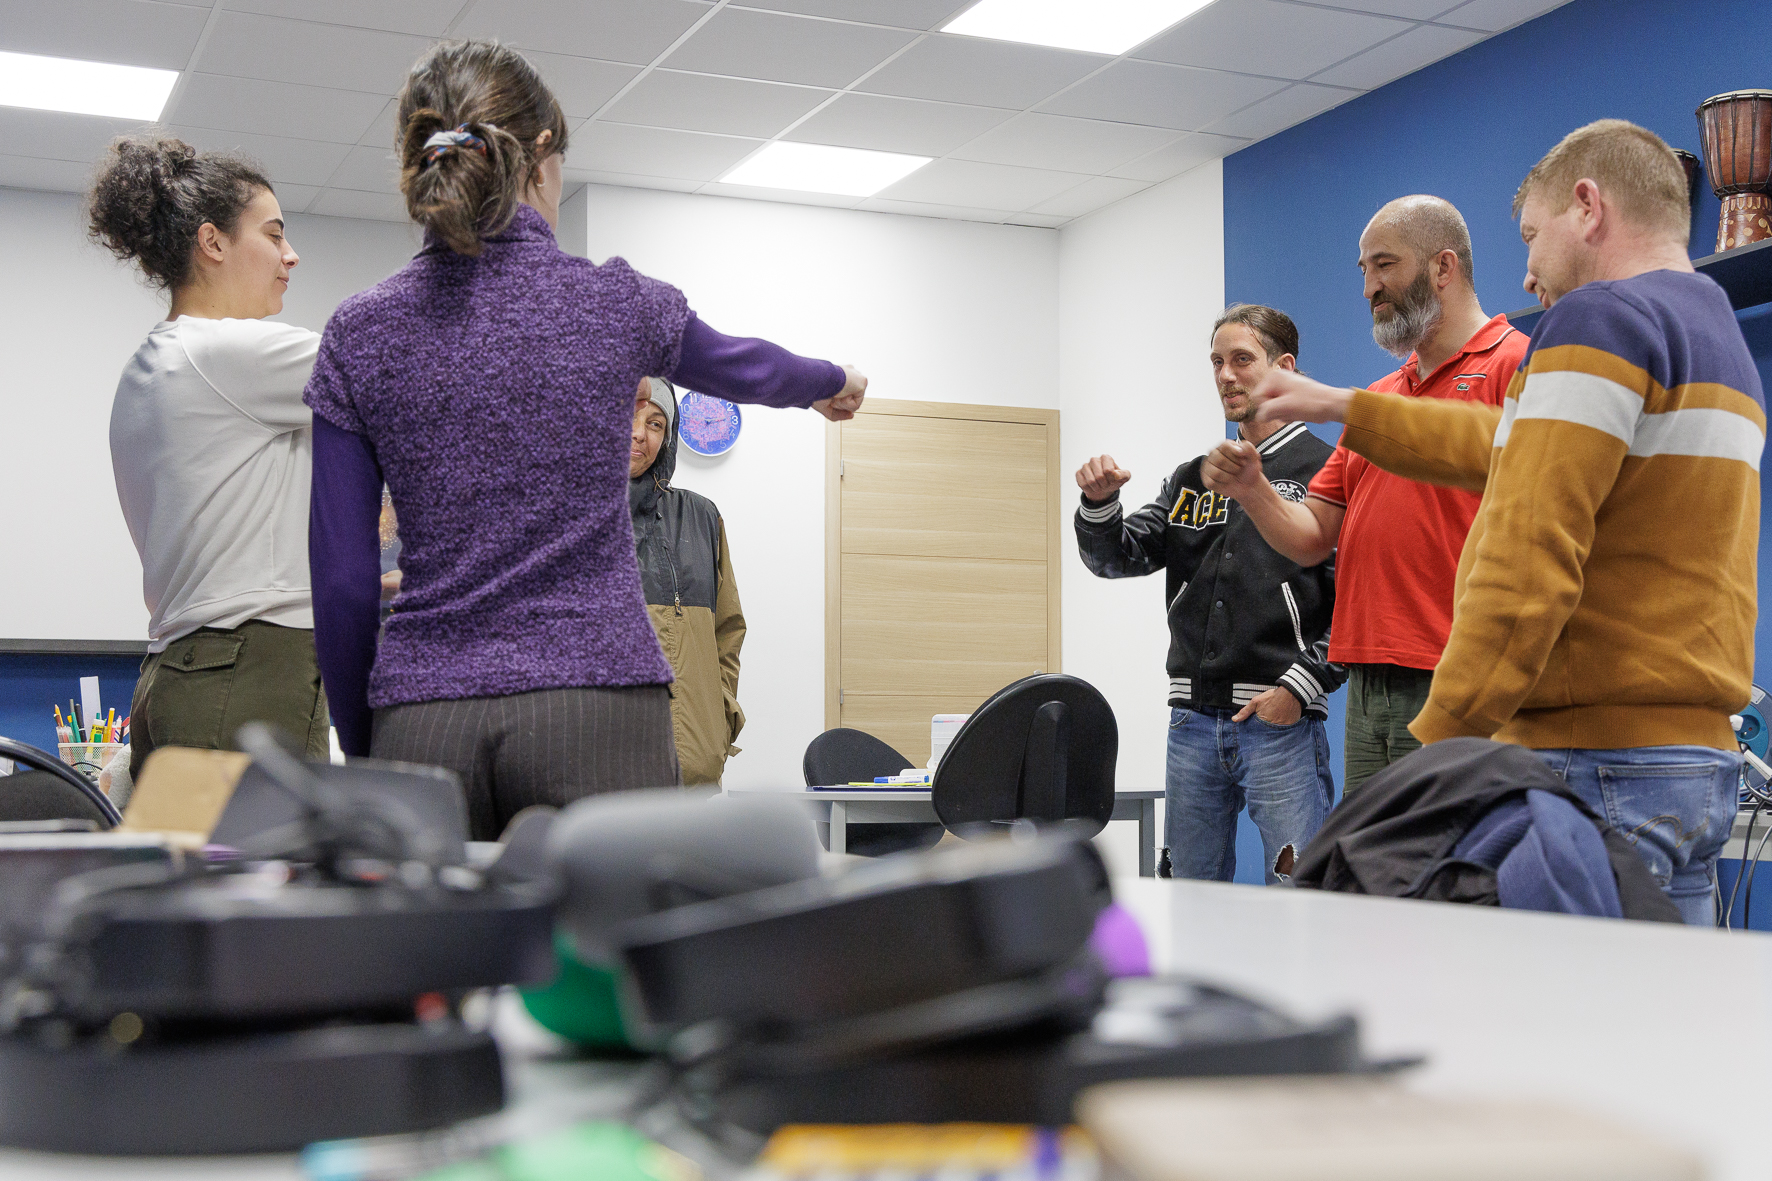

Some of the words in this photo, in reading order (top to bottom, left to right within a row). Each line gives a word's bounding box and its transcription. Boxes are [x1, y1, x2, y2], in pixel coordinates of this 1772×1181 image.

[689, 392, 698, 402] 11
[680, 403, 690, 413] 10
[726, 402, 734, 412] 2
[732, 416, 738, 424] 3
[683, 430, 690, 440] 8
[707, 443, 713, 452] 6
[720, 439, 727, 449] 5
[1168, 486, 1230, 531] ACE
